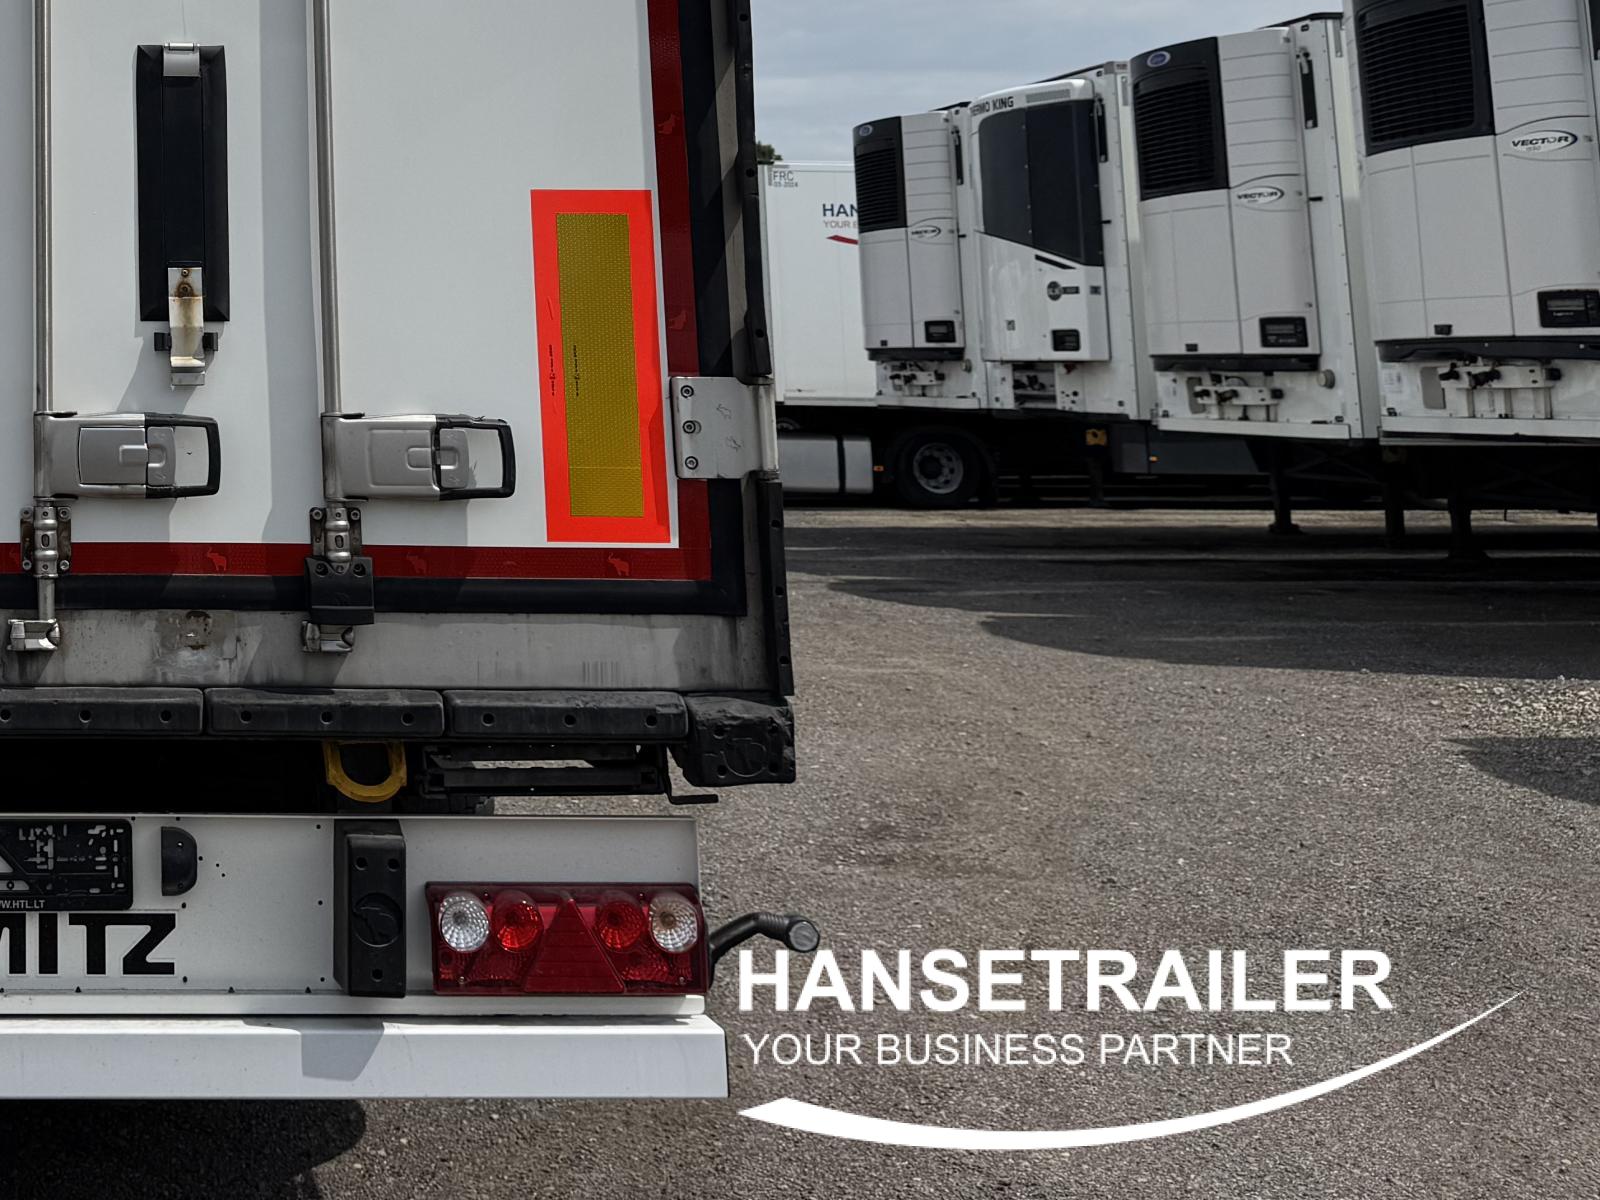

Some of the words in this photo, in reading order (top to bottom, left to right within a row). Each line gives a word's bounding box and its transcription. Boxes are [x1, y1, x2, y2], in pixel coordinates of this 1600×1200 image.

[992, 96, 1015, 111] KING
[1511, 136, 1570, 148] VECTOR
[772, 170, 794, 181] FRC
[823, 220, 851, 229] YOUR
